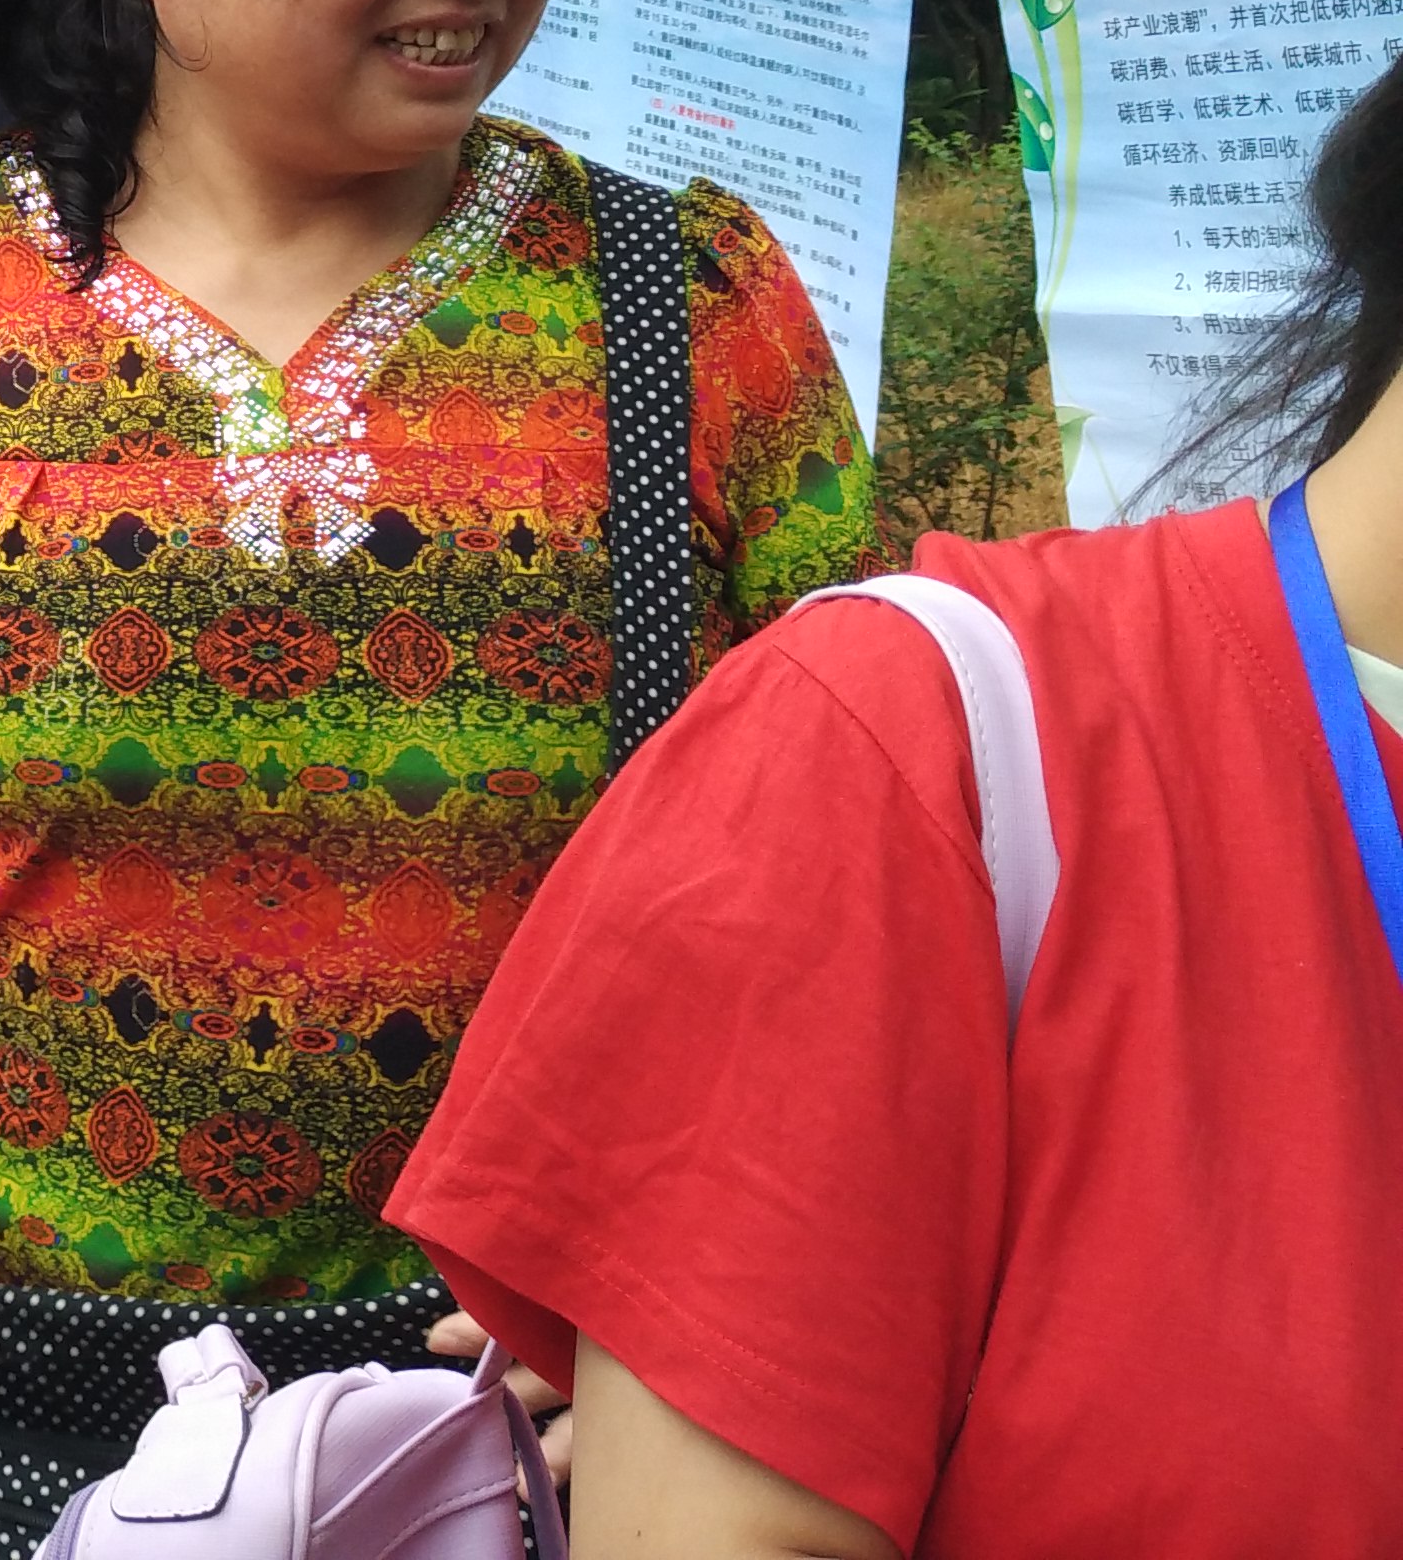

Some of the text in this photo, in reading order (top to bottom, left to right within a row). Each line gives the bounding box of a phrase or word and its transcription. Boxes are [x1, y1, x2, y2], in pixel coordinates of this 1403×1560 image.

[1117, 87, 1360, 125] 碳哲学、低碳艺术、低碳音
